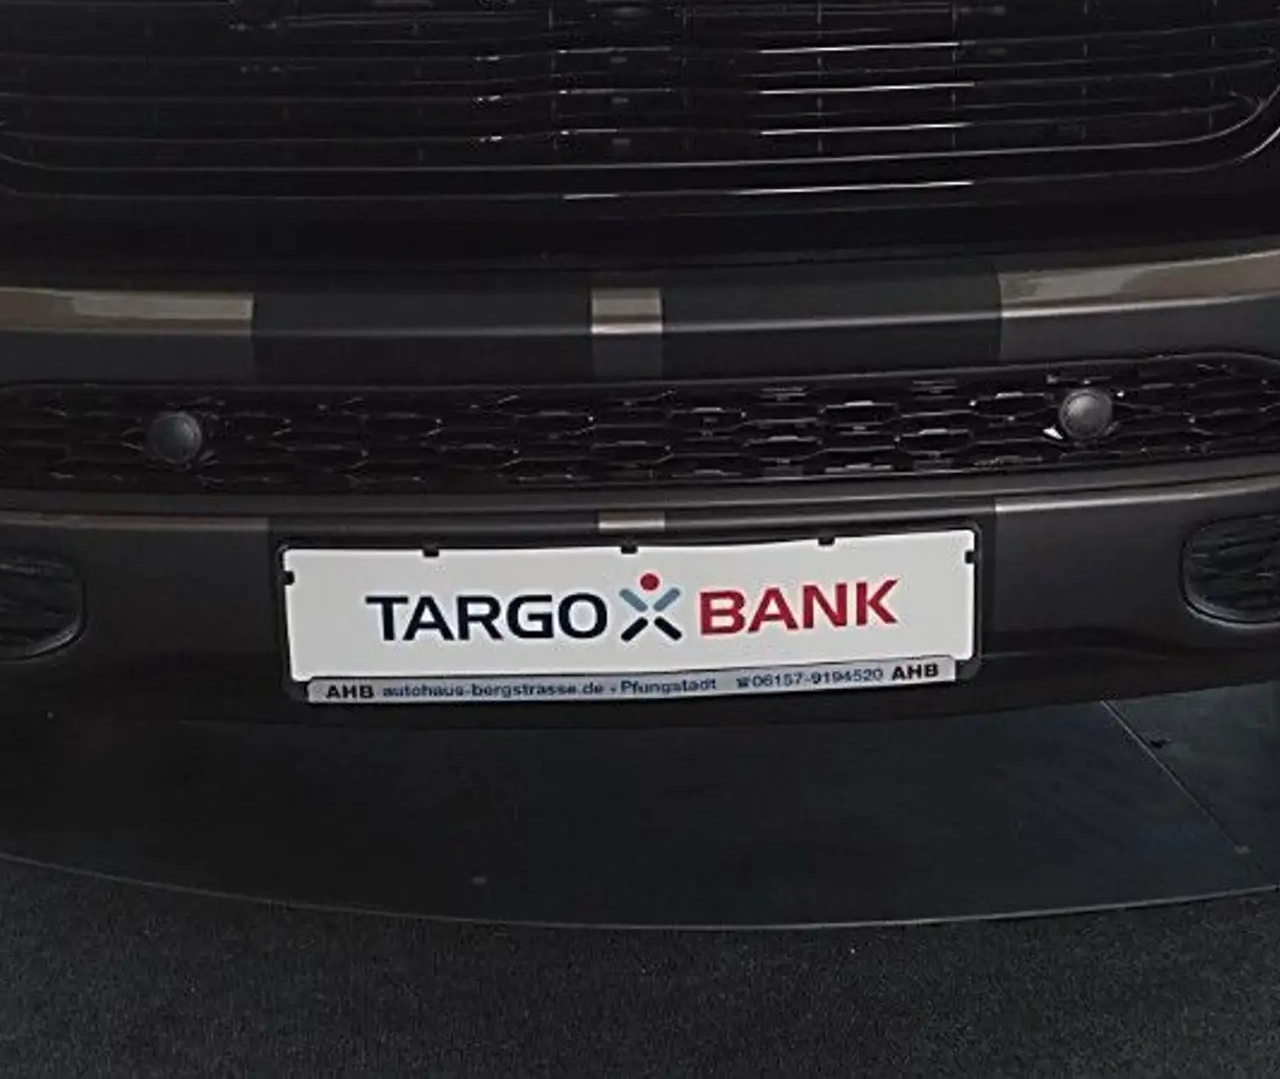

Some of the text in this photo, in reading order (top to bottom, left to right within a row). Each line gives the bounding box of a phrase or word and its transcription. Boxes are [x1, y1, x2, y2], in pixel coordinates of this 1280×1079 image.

[364, 578, 901, 643] TARGO BANK
[325, 683, 375, 699] AHB
[619, 676, 717, 696] Pfungstadt
[890, 662, 940, 682] AHB
